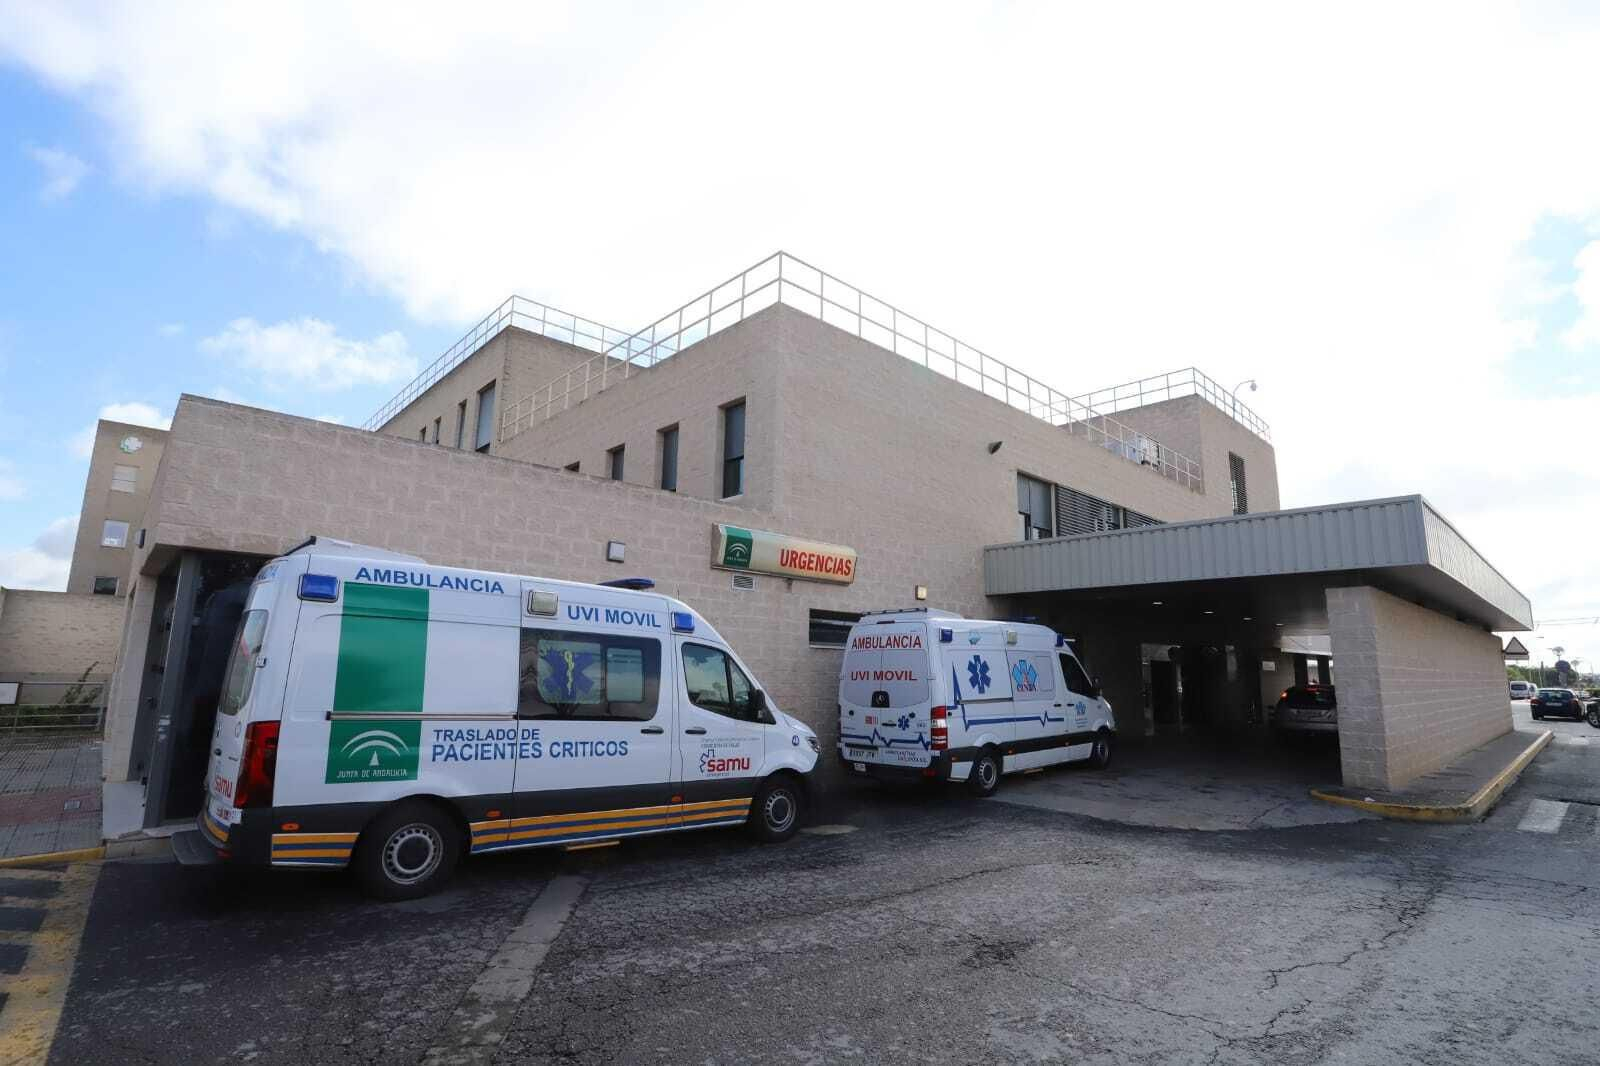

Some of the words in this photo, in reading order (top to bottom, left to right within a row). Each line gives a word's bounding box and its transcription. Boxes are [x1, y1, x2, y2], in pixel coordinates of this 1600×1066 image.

[780, 548, 852, 576] URGENCIAS
[355, 567, 504, 594] AMBULANCIA
[567, 604, 599, 622] UVI
[605, 609, 661, 628] MOVIL
[851, 634, 922, 650] AMBULANCIA
[851, 671, 871, 681] UVI
[872, 670, 918, 682] MOVIL
[433, 728, 517, 742] TRASLADO
[520, 728, 540, 741] DE
[431, 742, 543, 762] PACIENTES
[549, 740, 629, 758] CRITICOS
[707, 757, 750, 773] samu
[336, 769, 359, 779] JUNTA
[361, 769, 370, 778] DE
[372, 768, 408, 777] ANDALUCIA
